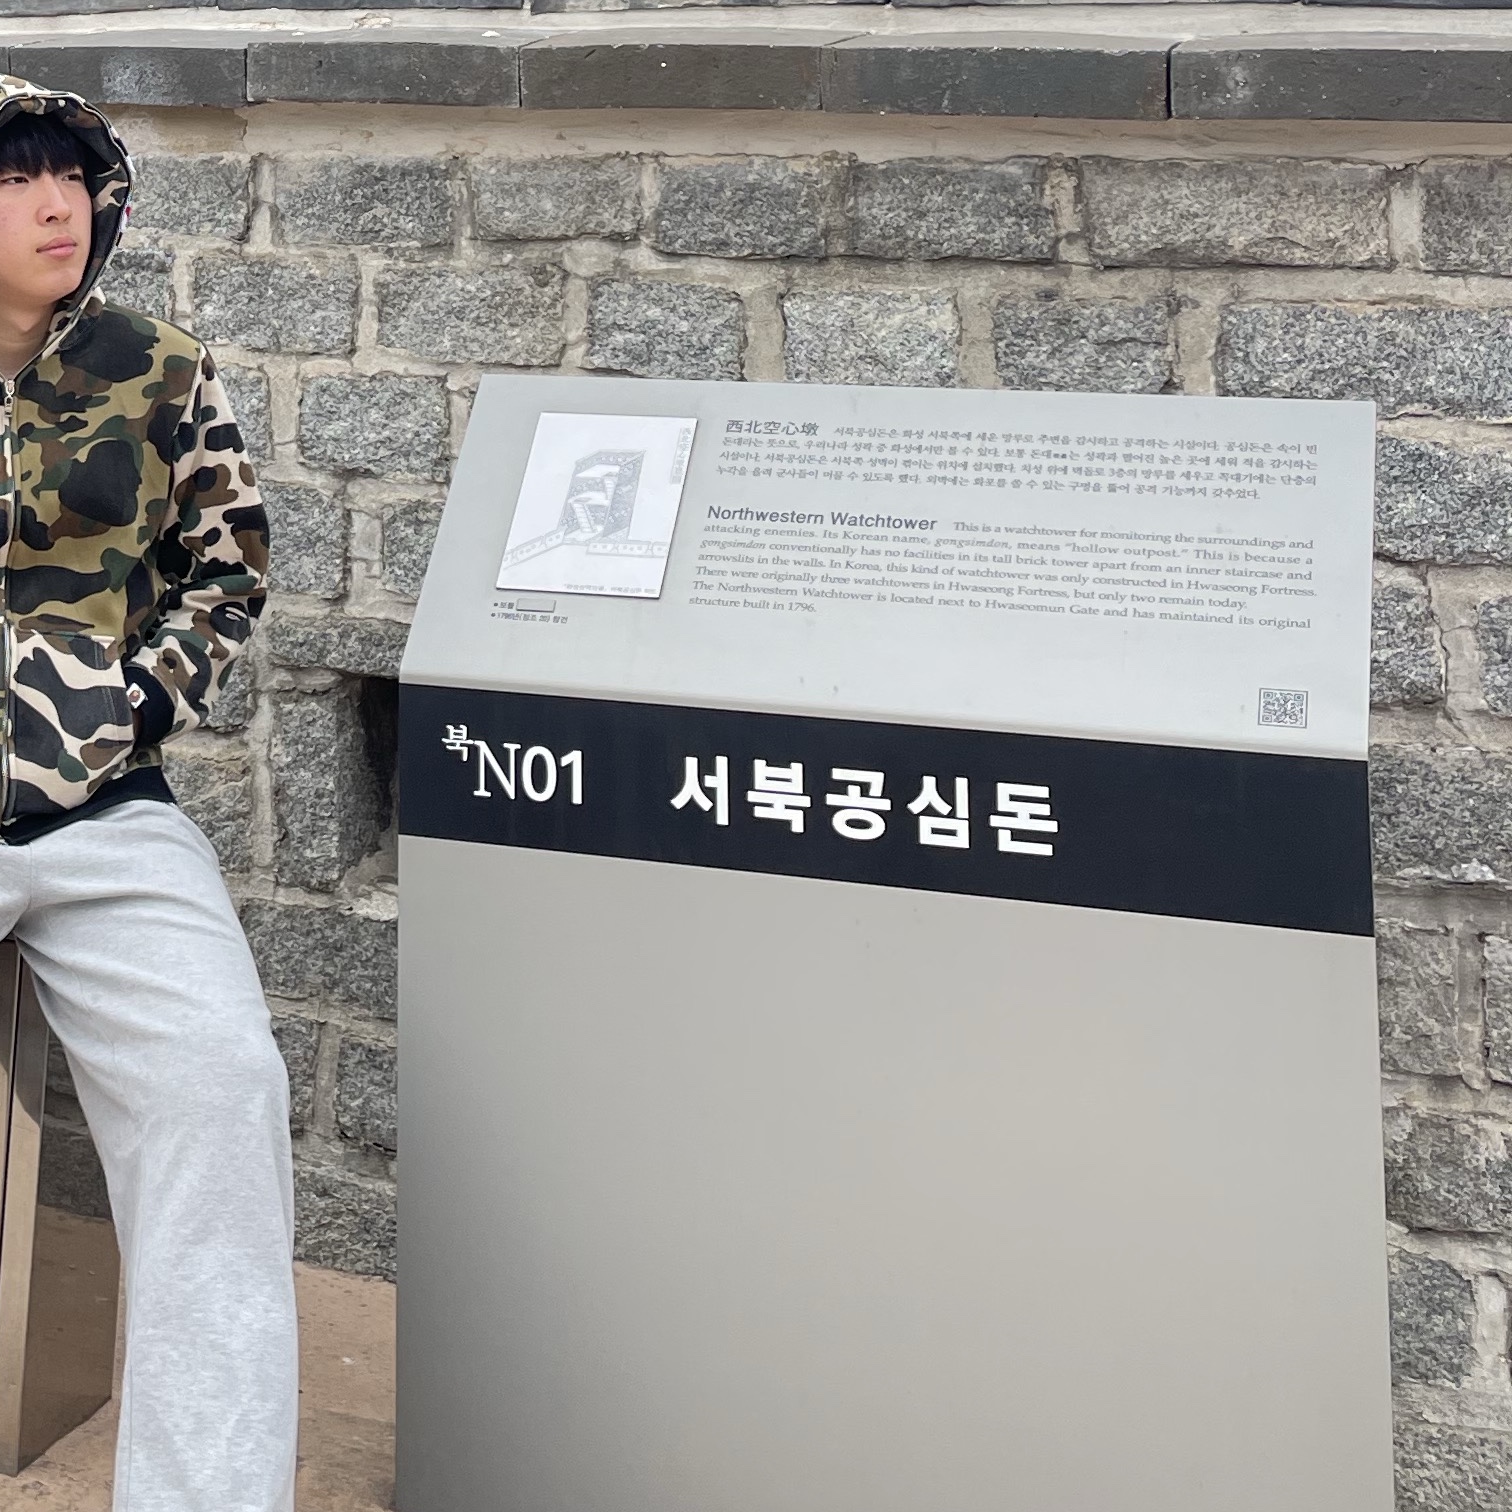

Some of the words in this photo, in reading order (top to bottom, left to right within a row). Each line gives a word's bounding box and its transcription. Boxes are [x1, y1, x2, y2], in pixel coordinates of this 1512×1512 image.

[725, 419, 819, 436] 西北空心墩
[707, 505, 824, 524] Northwestern
[830, 511, 938, 530] Watchtower
[952, 521, 979, 531] This
[981, 523, 991, 532] is
[1003, 524, 1077, 536] watchtower
[1079, 527, 1098, 538] for
[1100, 531, 1171, 544] monitoring
[1174, 532, 1194, 542] the
[1197, 536, 1285, 550] surroundings
[1288, 539, 1313, 549] and
[699, 539, 766, 549] gongsimdon
[768, 543, 857, 557] conventionally
[860, 545, 881, 555] has
[903, 548, 954, 560] facilities
[973, 553, 988, 562] its
[992, 554, 1012, 563] tall
[1015, 554, 1047, 565] brick
[1051, 558, 1088, 567] tower
[1092, 561, 1126, 571] apart
[1130, 560, 1161, 571] from
[1185, 564, 1221, 575] inner
[1224, 567, 1283, 578] staircase
[1286, 570, 1312, 580] and
[703, 524, 760, 537] attacking
[763, 528, 814, 537] enemies.
[822, 529, 838, 538] Its
[842, 530, 888, 541] Korean
[892, 535, 927, 543] name,
[933, 538, 1012, 549] gongsimdon,
[1017, 542, 1060, 551] means
[1065, 542, 1119, 553] “hollow
[1123, 547, 1188, 558] outpost.”
[1193, 549, 1223, 560] This
[1228, 551, 1239, 561] is
[1244, 551, 1300, 564] because
[695, 565, 728, 576] There
[730, 570, 759, 578] were
[761, 571, 817, 584] originally
[820, 572, 850, 584] three
[853, 576, 929, 589] watchtowers
[932, 581, 944, 590] in
[948, 581, 1014, 596] Hwaseong
[1017, 585, 1069, 598] Fortress,
[1073, 588, 1094, 599] but
[1098, 591, 1127, 603] only
[1130, 593, 1155, 602] two
[1158, 596, 1204, 605] remain
[1208, 597, 1246, 611] today.
[697, 553, 754, 563] arrowslits
[771, 555, 790, 565] the
[792, 557, 825, 567] walls.
[830, 559, 841, 568] In
[844, 560, 882, 572] Korea,
[886, 562, 908, 572] this
[910, 563, 938, 574] kind
[941, 566, 955, 575] of
[957, 567, 1030, 579] watchtower
[1033, 573, 1058, 581] was
[1060, 573, 1089, 586] only
[1092, 577, 1166, 587] constructed
[1170, 578, 1183, 588] in
[1186, 579, 1257, 596] Hwaseong
[1260, 584, 1316, 596] Fortress.
[688, 596, 740, 607] structure
[742, 598, 769, 609] built
[772, 601, 784, 610] in
[787, 601, 816, 612] 1796.
[692, 580, 714, 590] The
[717, 582, 797, 595] Northwestern
[802, 587, 873, 600] Watchtower
[876, 592, 886, 601] is
[890, 592, 933, 604] located
[937, 598, 964, 606] next
[968, 599, 981, 607] to
[984, 599, 1065, 613] Hwaseomun
[1069, 604, 1099, 615] Gate
[1103, 607, 1127, 617] and
[1132, 607, 1154, 618] has
[1158, 612, 1233, 623] maintained
[1238, 615, 1254, 624] its
[1258, 617, 1310, 630] original
[670, 754, 1060, 857] 서북공심돈
